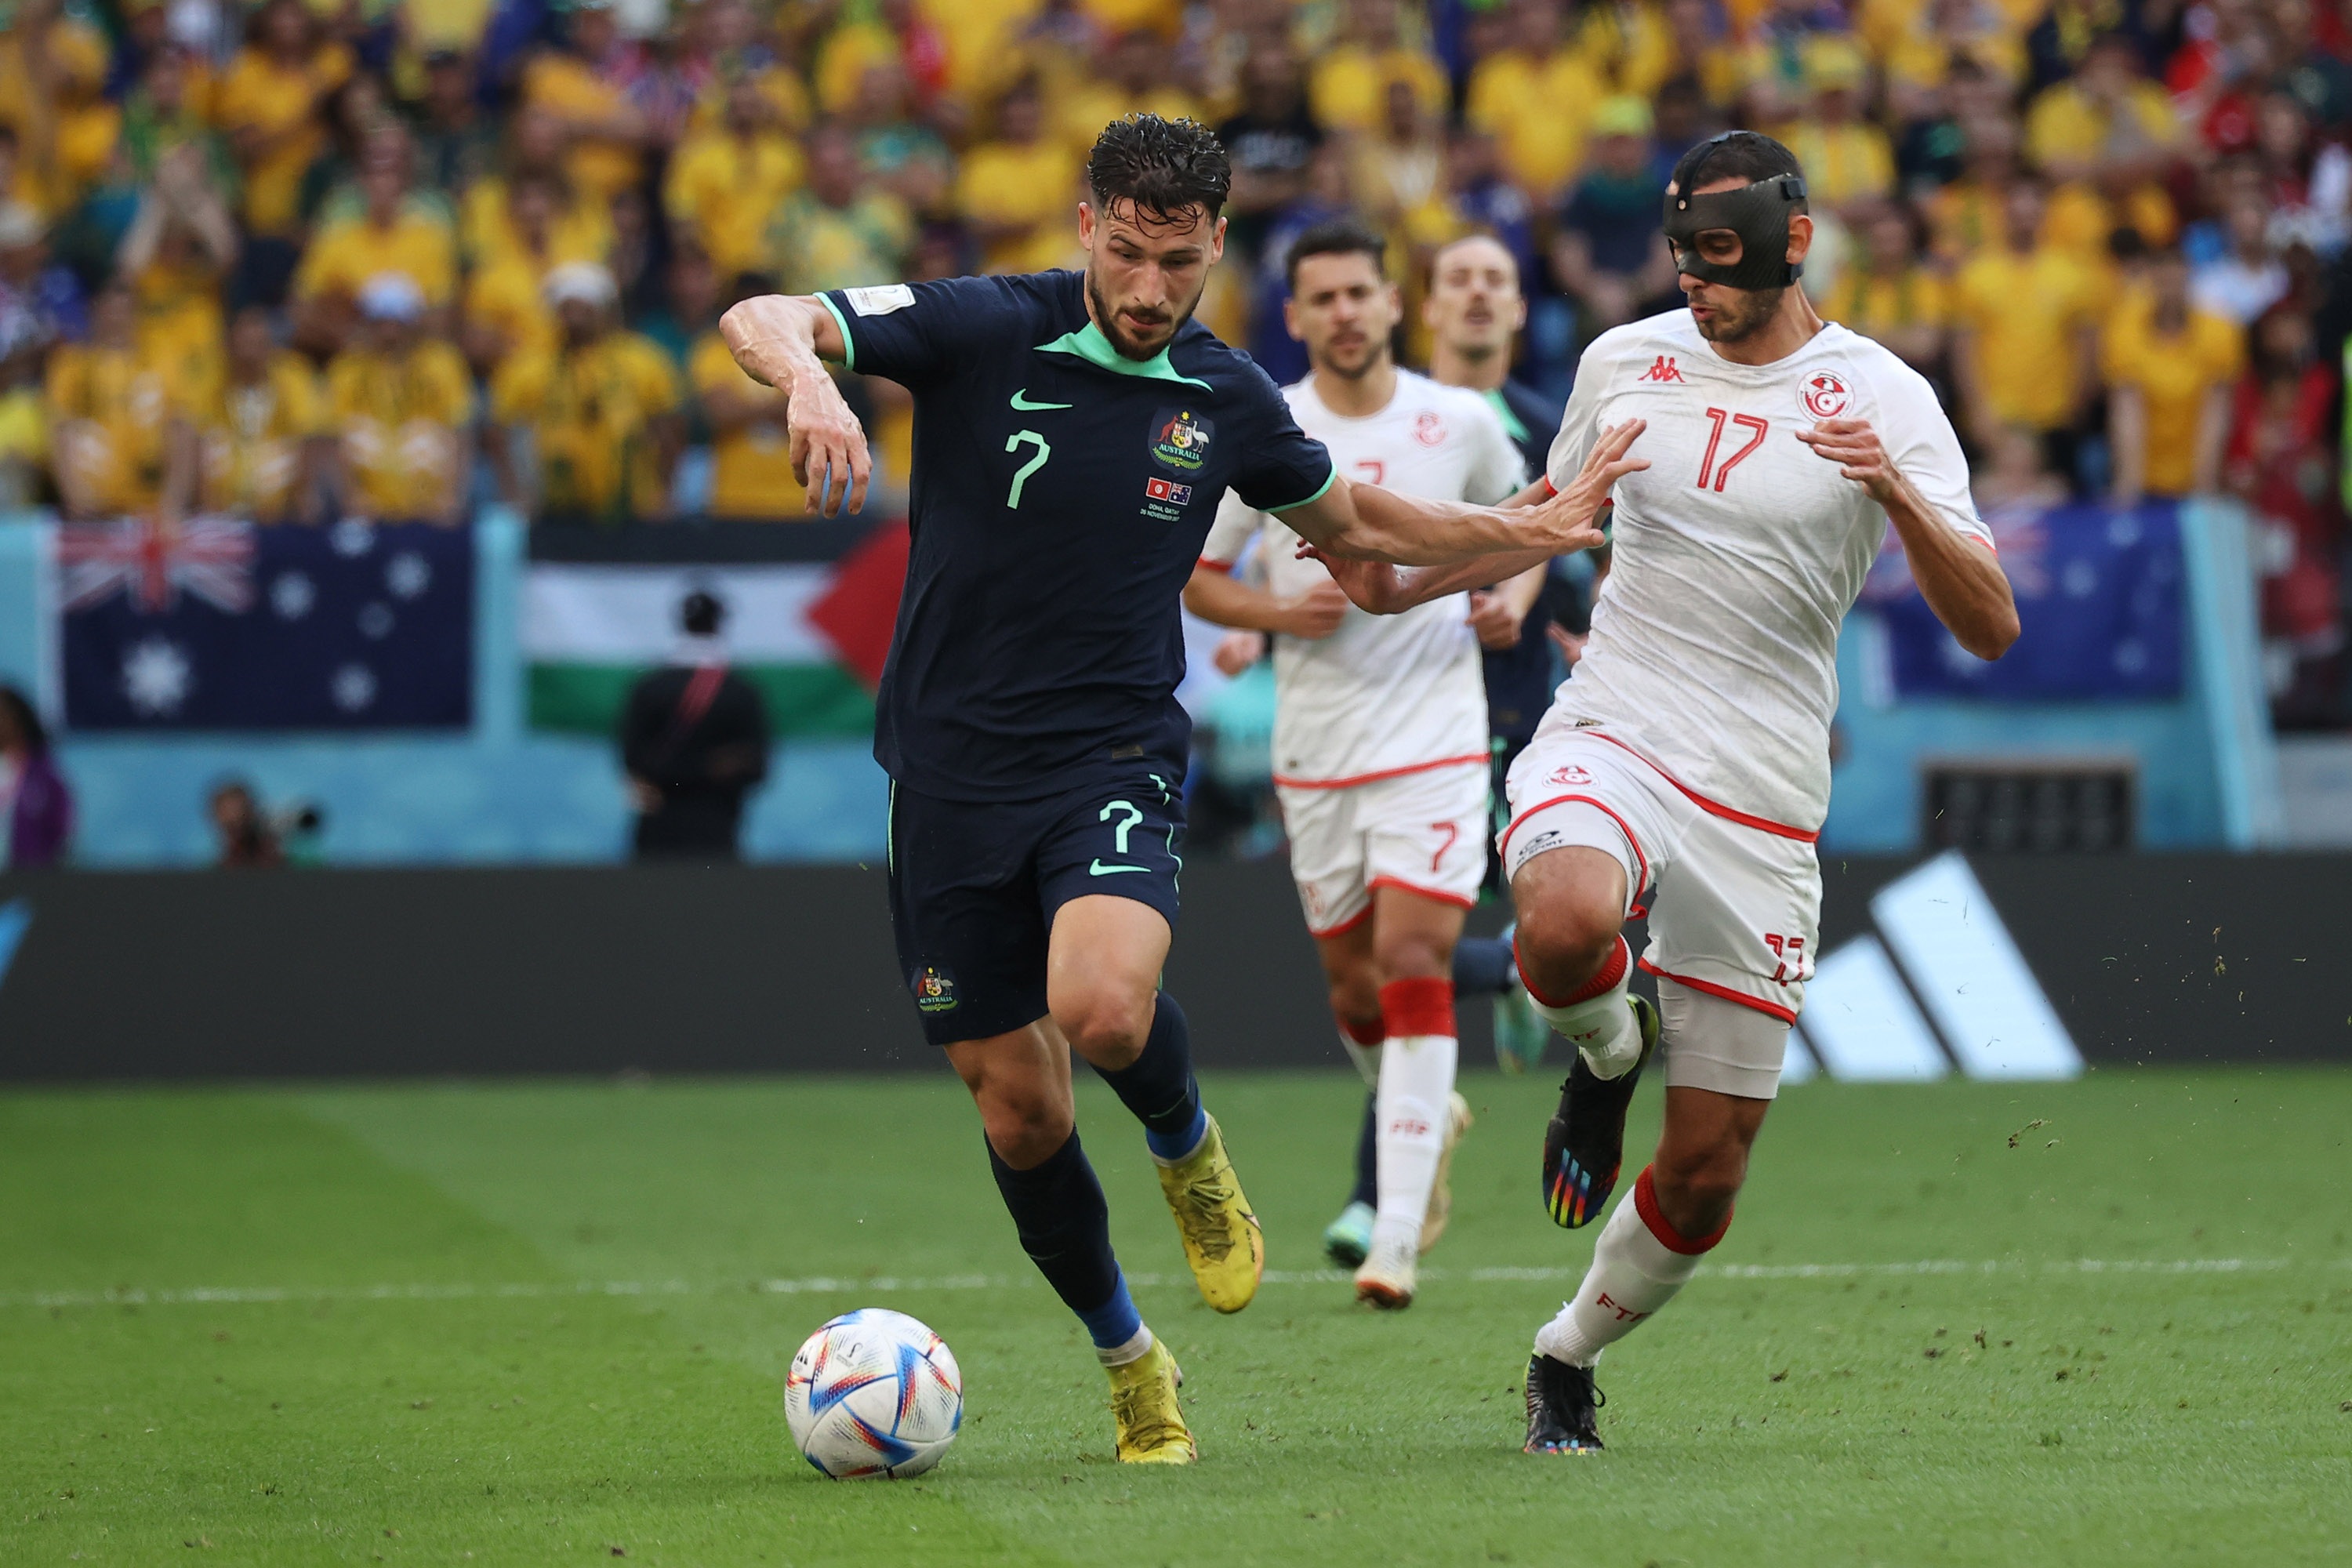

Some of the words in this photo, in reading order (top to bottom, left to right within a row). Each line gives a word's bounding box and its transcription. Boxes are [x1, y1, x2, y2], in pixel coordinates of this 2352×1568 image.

[1004, 429, 1051, 510] 7
[1159, 443, 1200, 461] AUSTRALIA
[1697, 407, 1769, 492] 17
[1431, 821, 1457, 873] 7
[920, 996, 953, 1004] AUSTRALIA
